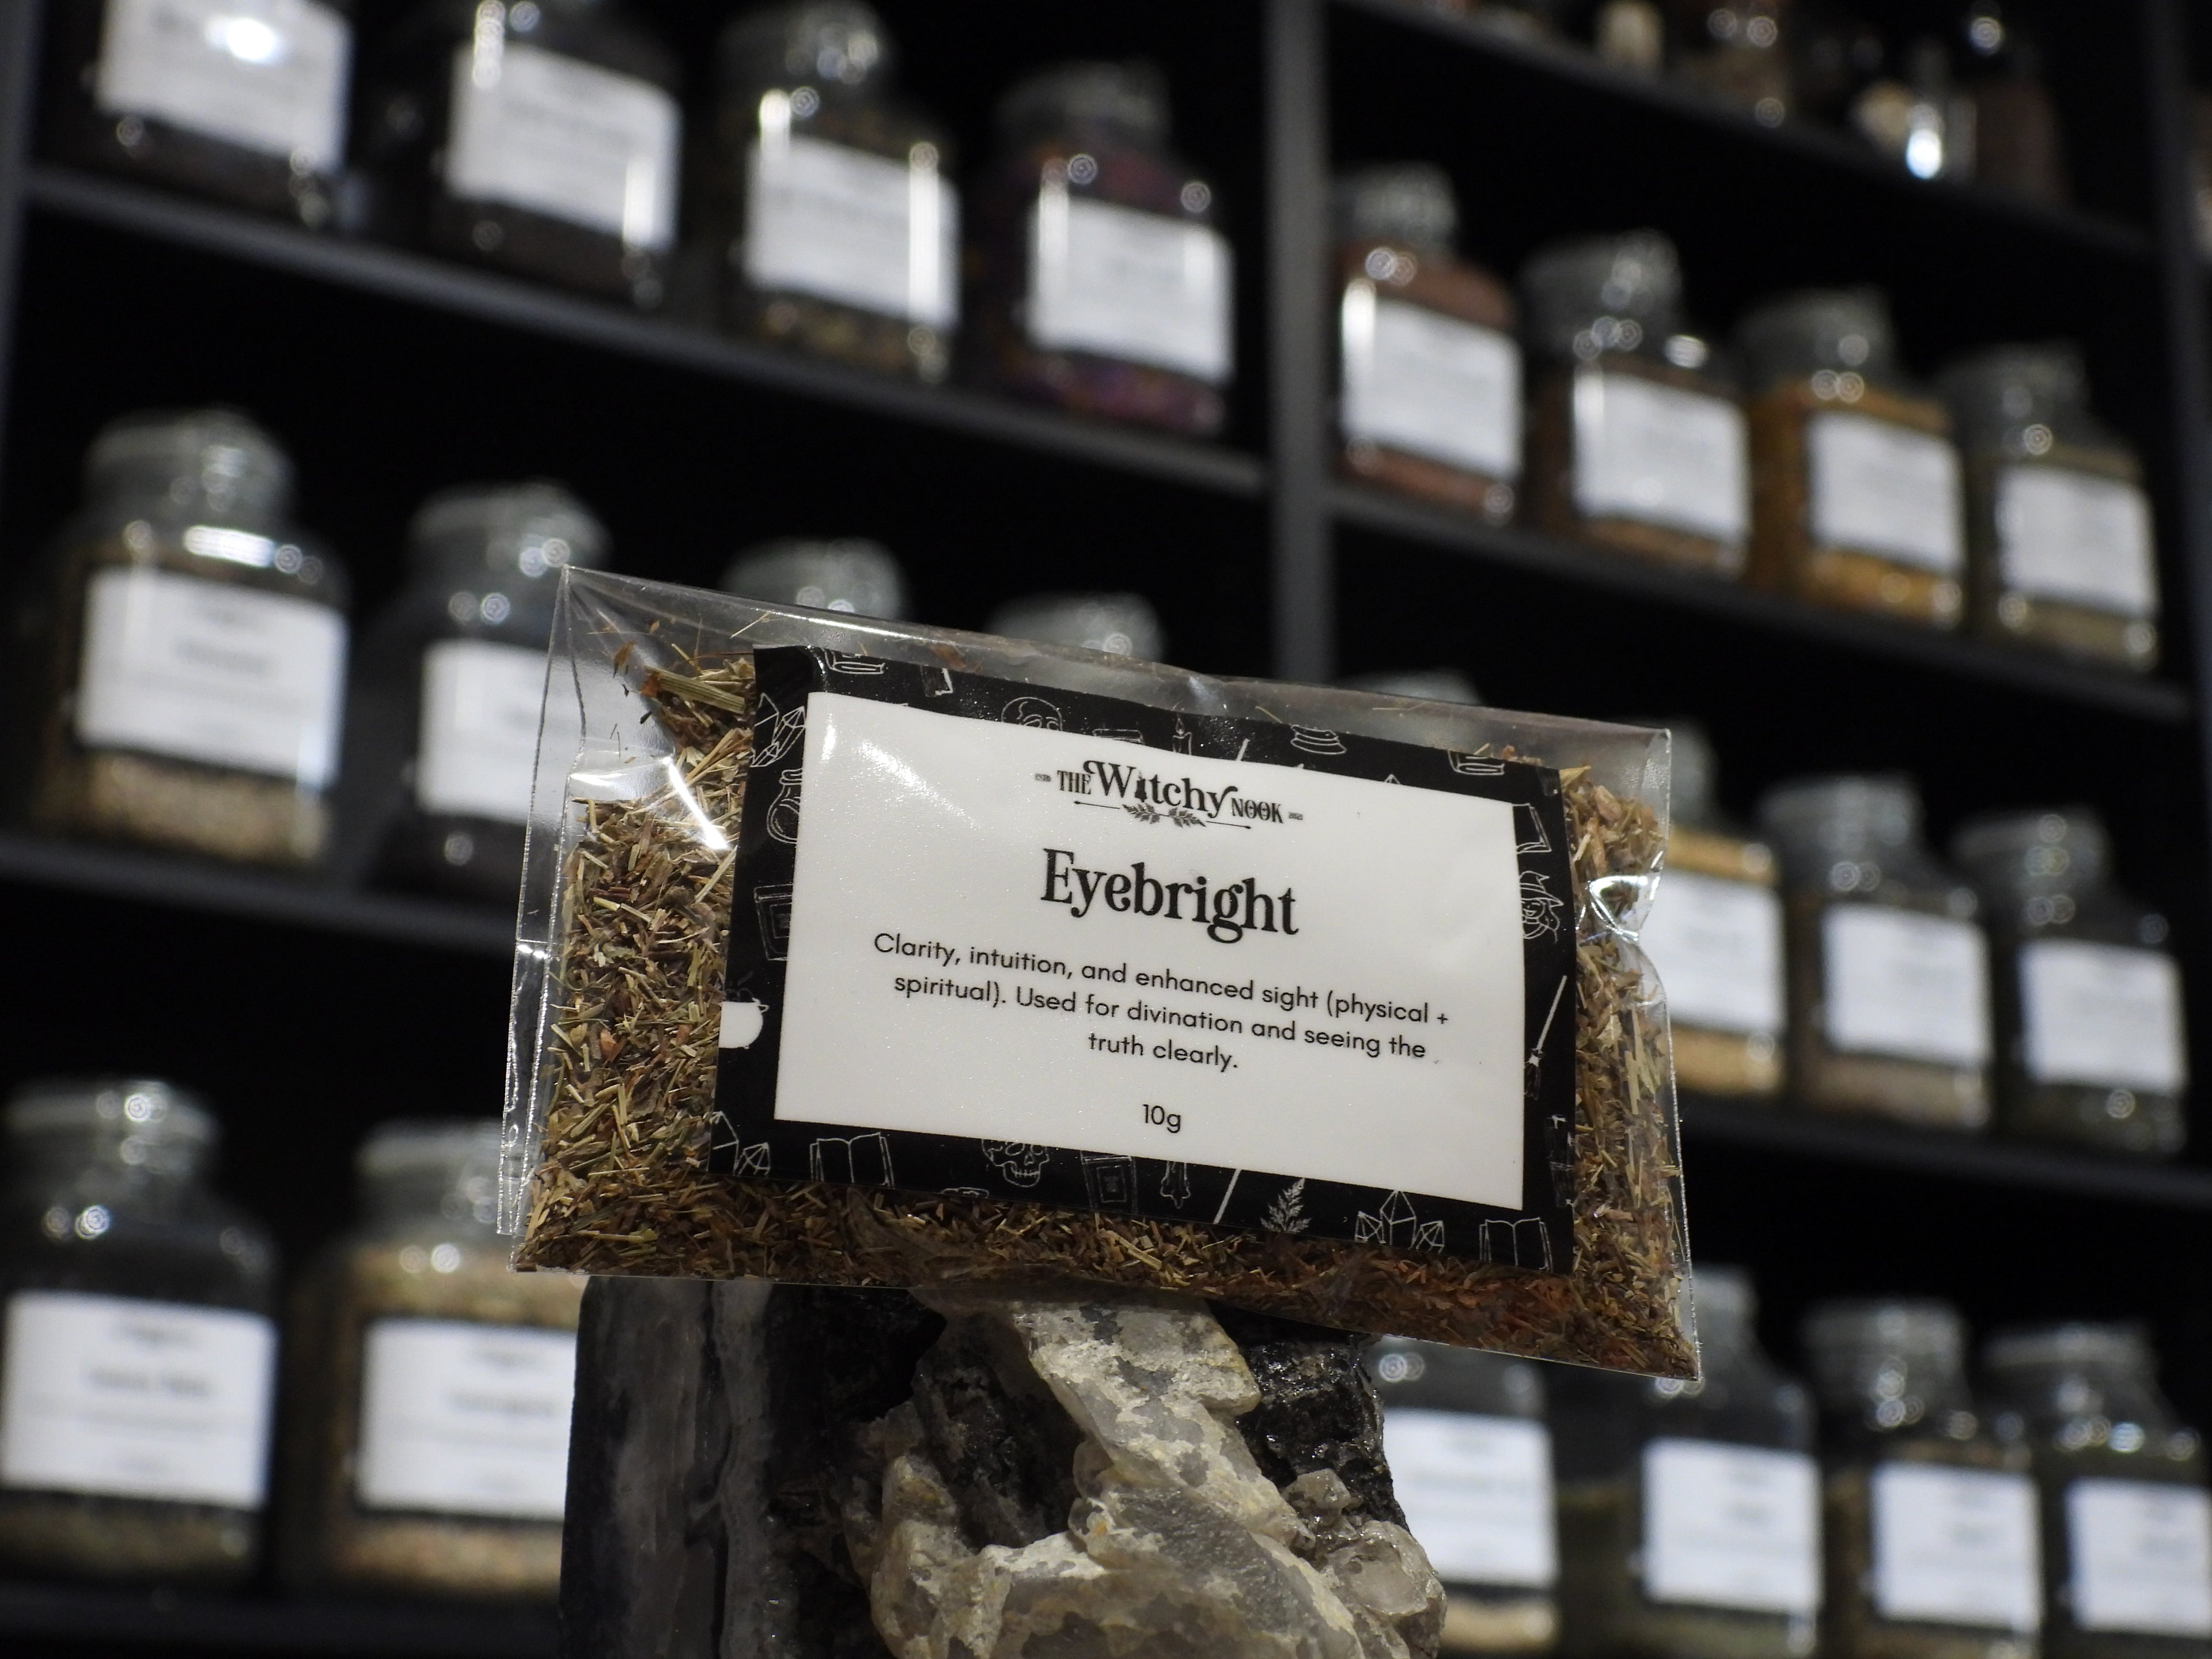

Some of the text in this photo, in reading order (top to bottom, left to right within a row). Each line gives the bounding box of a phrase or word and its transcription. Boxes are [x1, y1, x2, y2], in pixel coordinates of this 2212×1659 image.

[1056, 770, 1092, 796] THE
[1230, 797, 1284, 824] NOOK
[1040, 847, 1300, 944] Eyebright
[873, 932, 1449, 1025] Clarity, intuition, and enhanced sight (physical +
[893, 976, 1426, 1059] spiritual). Used for divination and seeing the
[1087, 1032, 1238, 1073] truth clearly.
[1142, 1104, 1182, 1134] 10g
